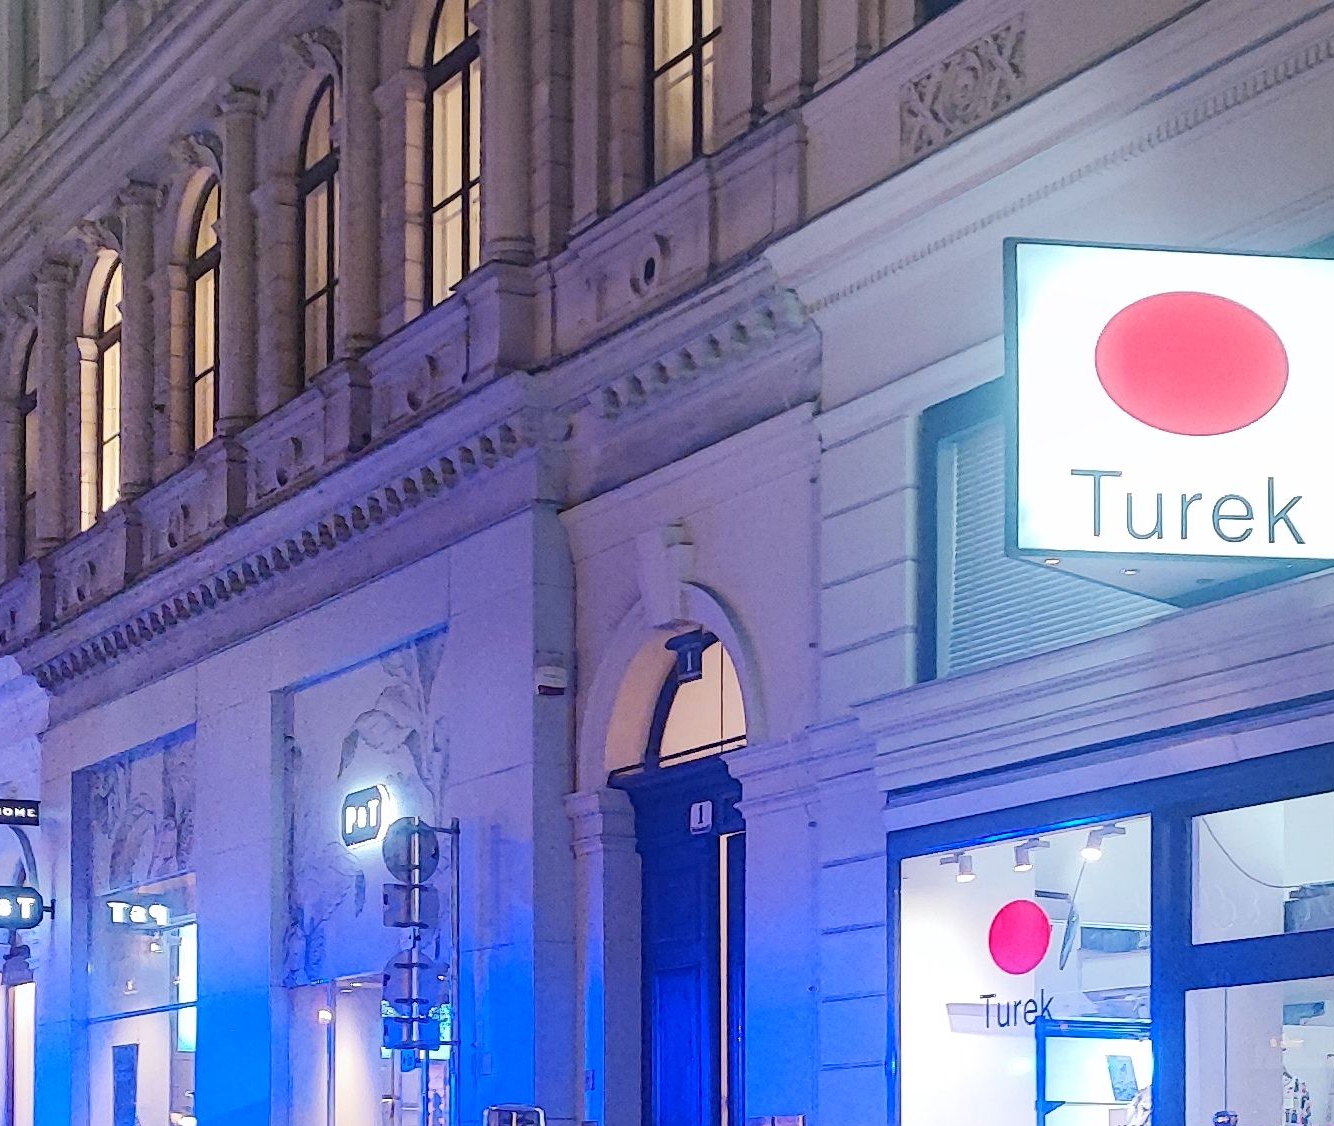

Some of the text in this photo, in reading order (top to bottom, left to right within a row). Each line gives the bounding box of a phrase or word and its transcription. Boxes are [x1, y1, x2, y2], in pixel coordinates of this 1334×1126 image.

[1070, 468, 1305, 545] Turek
[697, 804, 704, 825] 1
[979, 989, 1055, 1029] Turek
